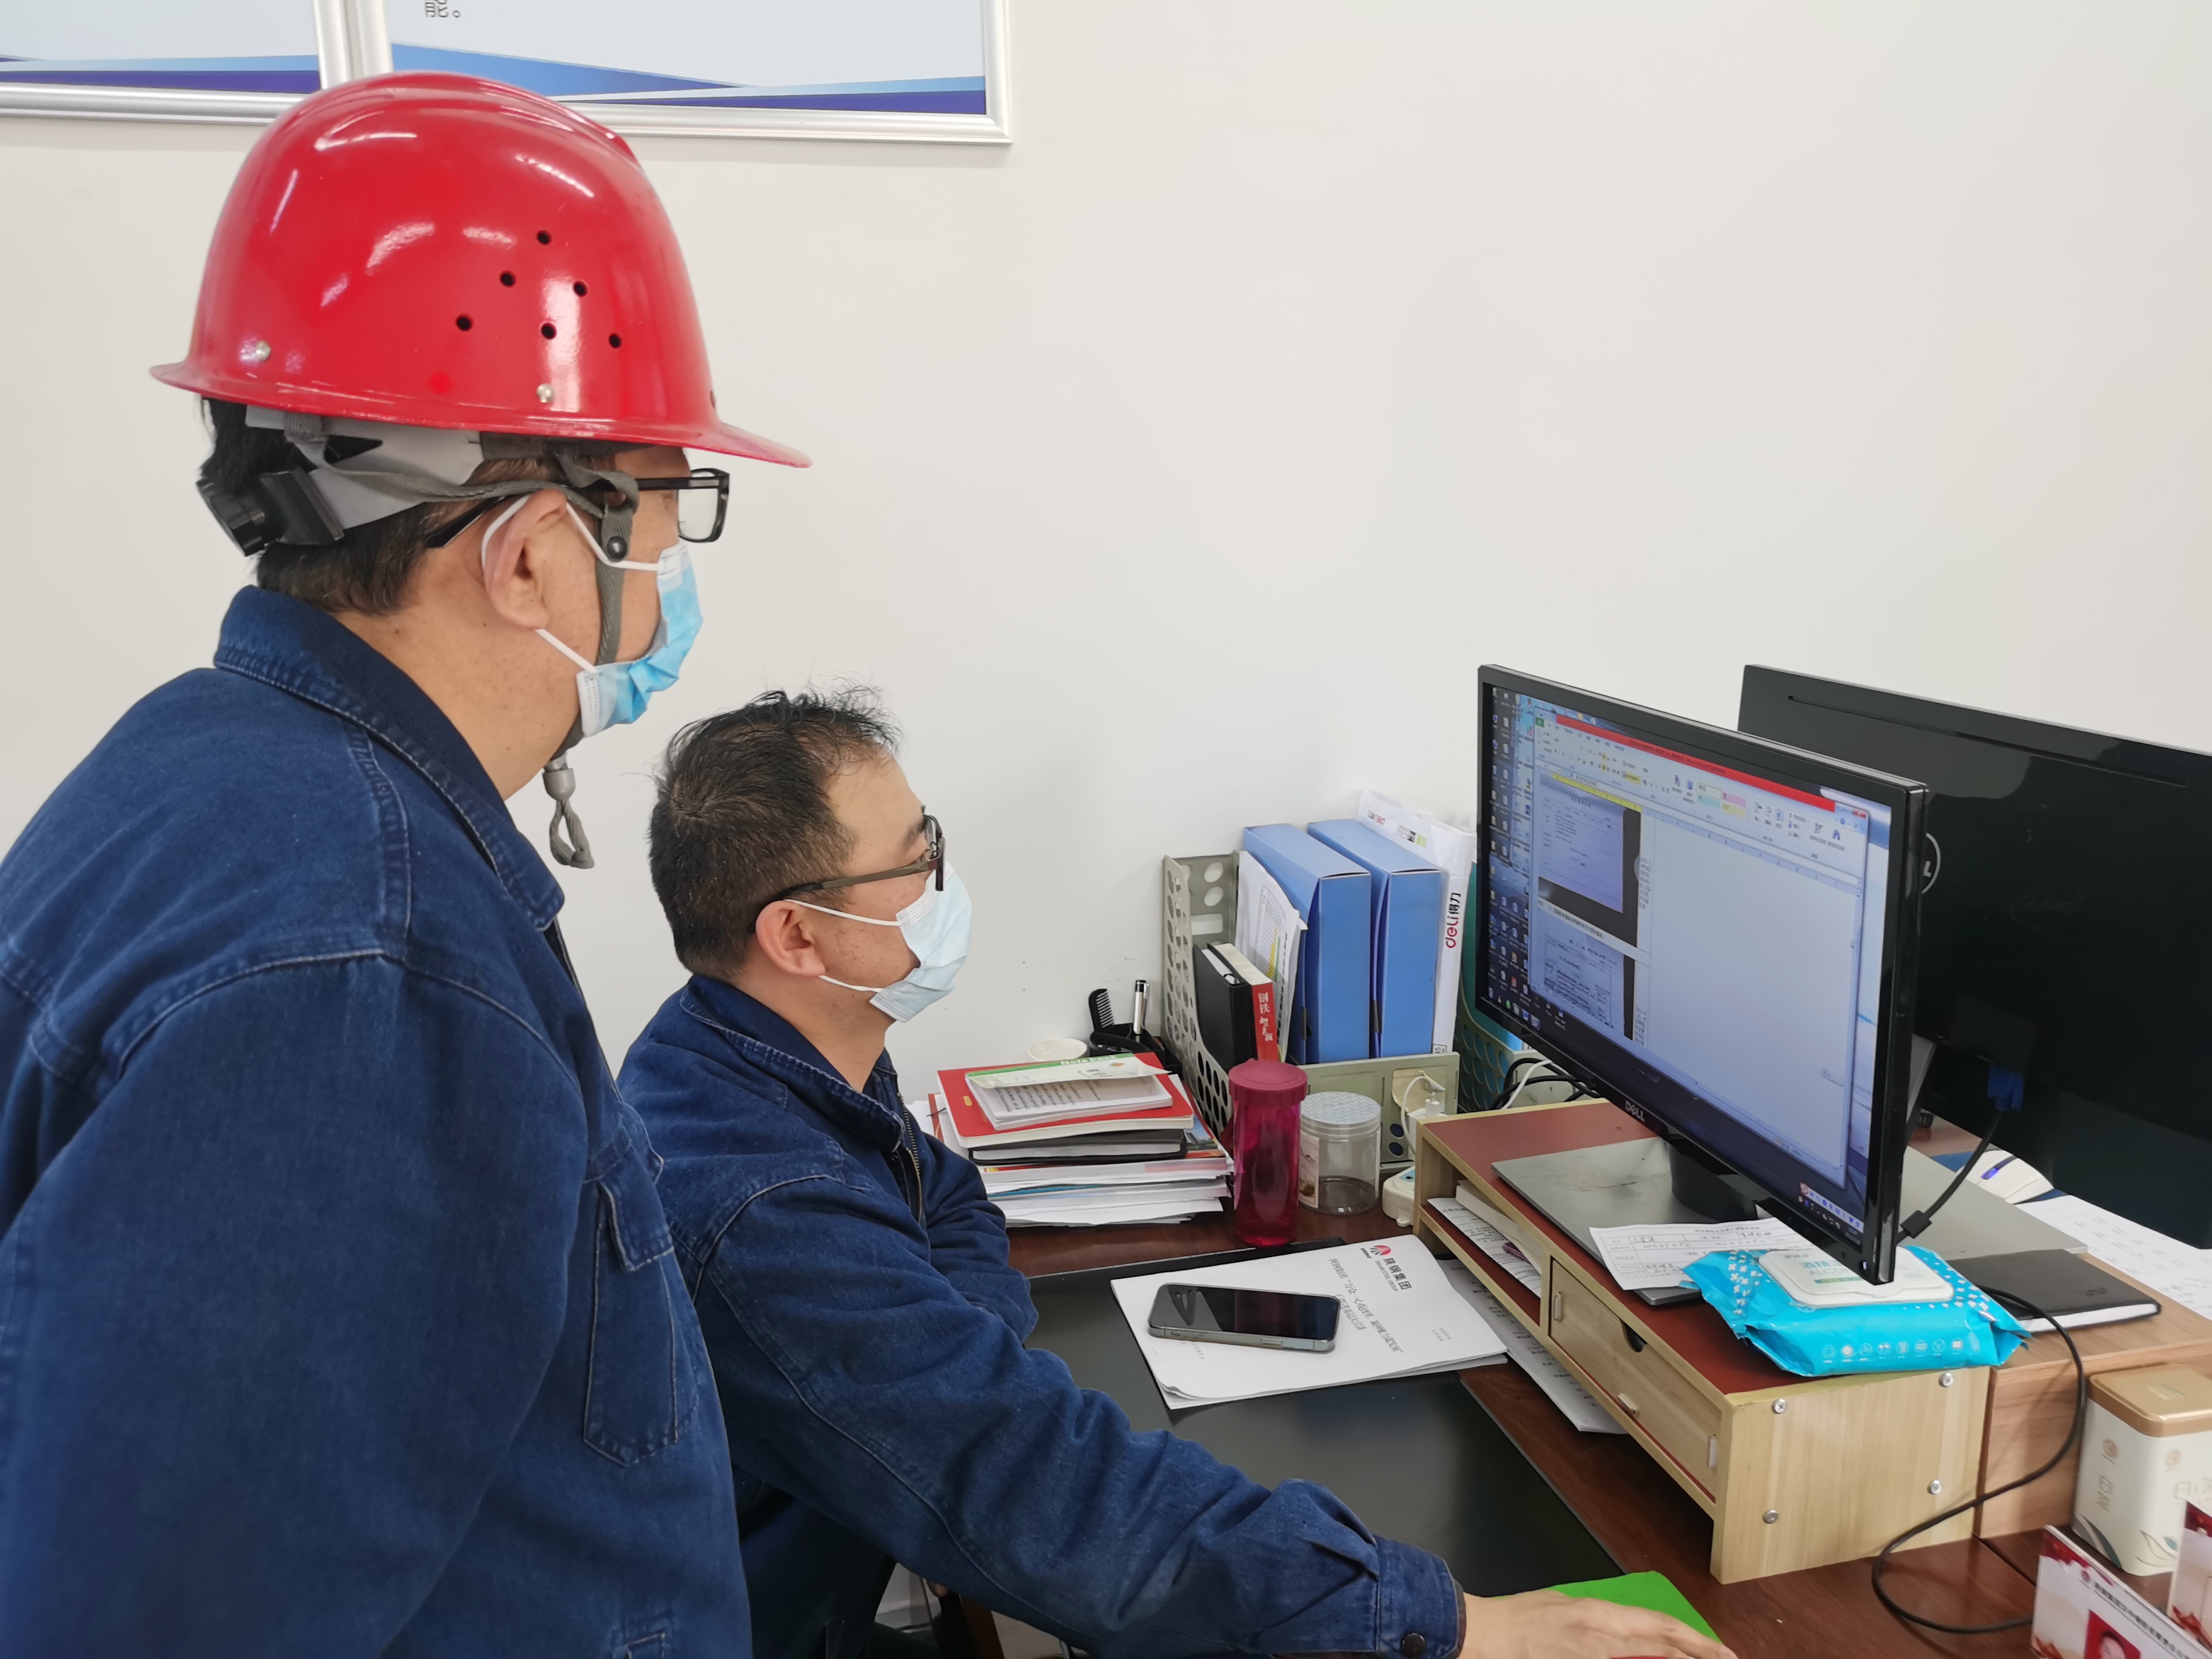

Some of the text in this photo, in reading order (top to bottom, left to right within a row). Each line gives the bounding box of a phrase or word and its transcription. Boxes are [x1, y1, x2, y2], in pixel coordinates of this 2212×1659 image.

[1626, 1100, 1644, 1122] DELL
[1382, 1258, 1412, 1290] 陕钢集团
